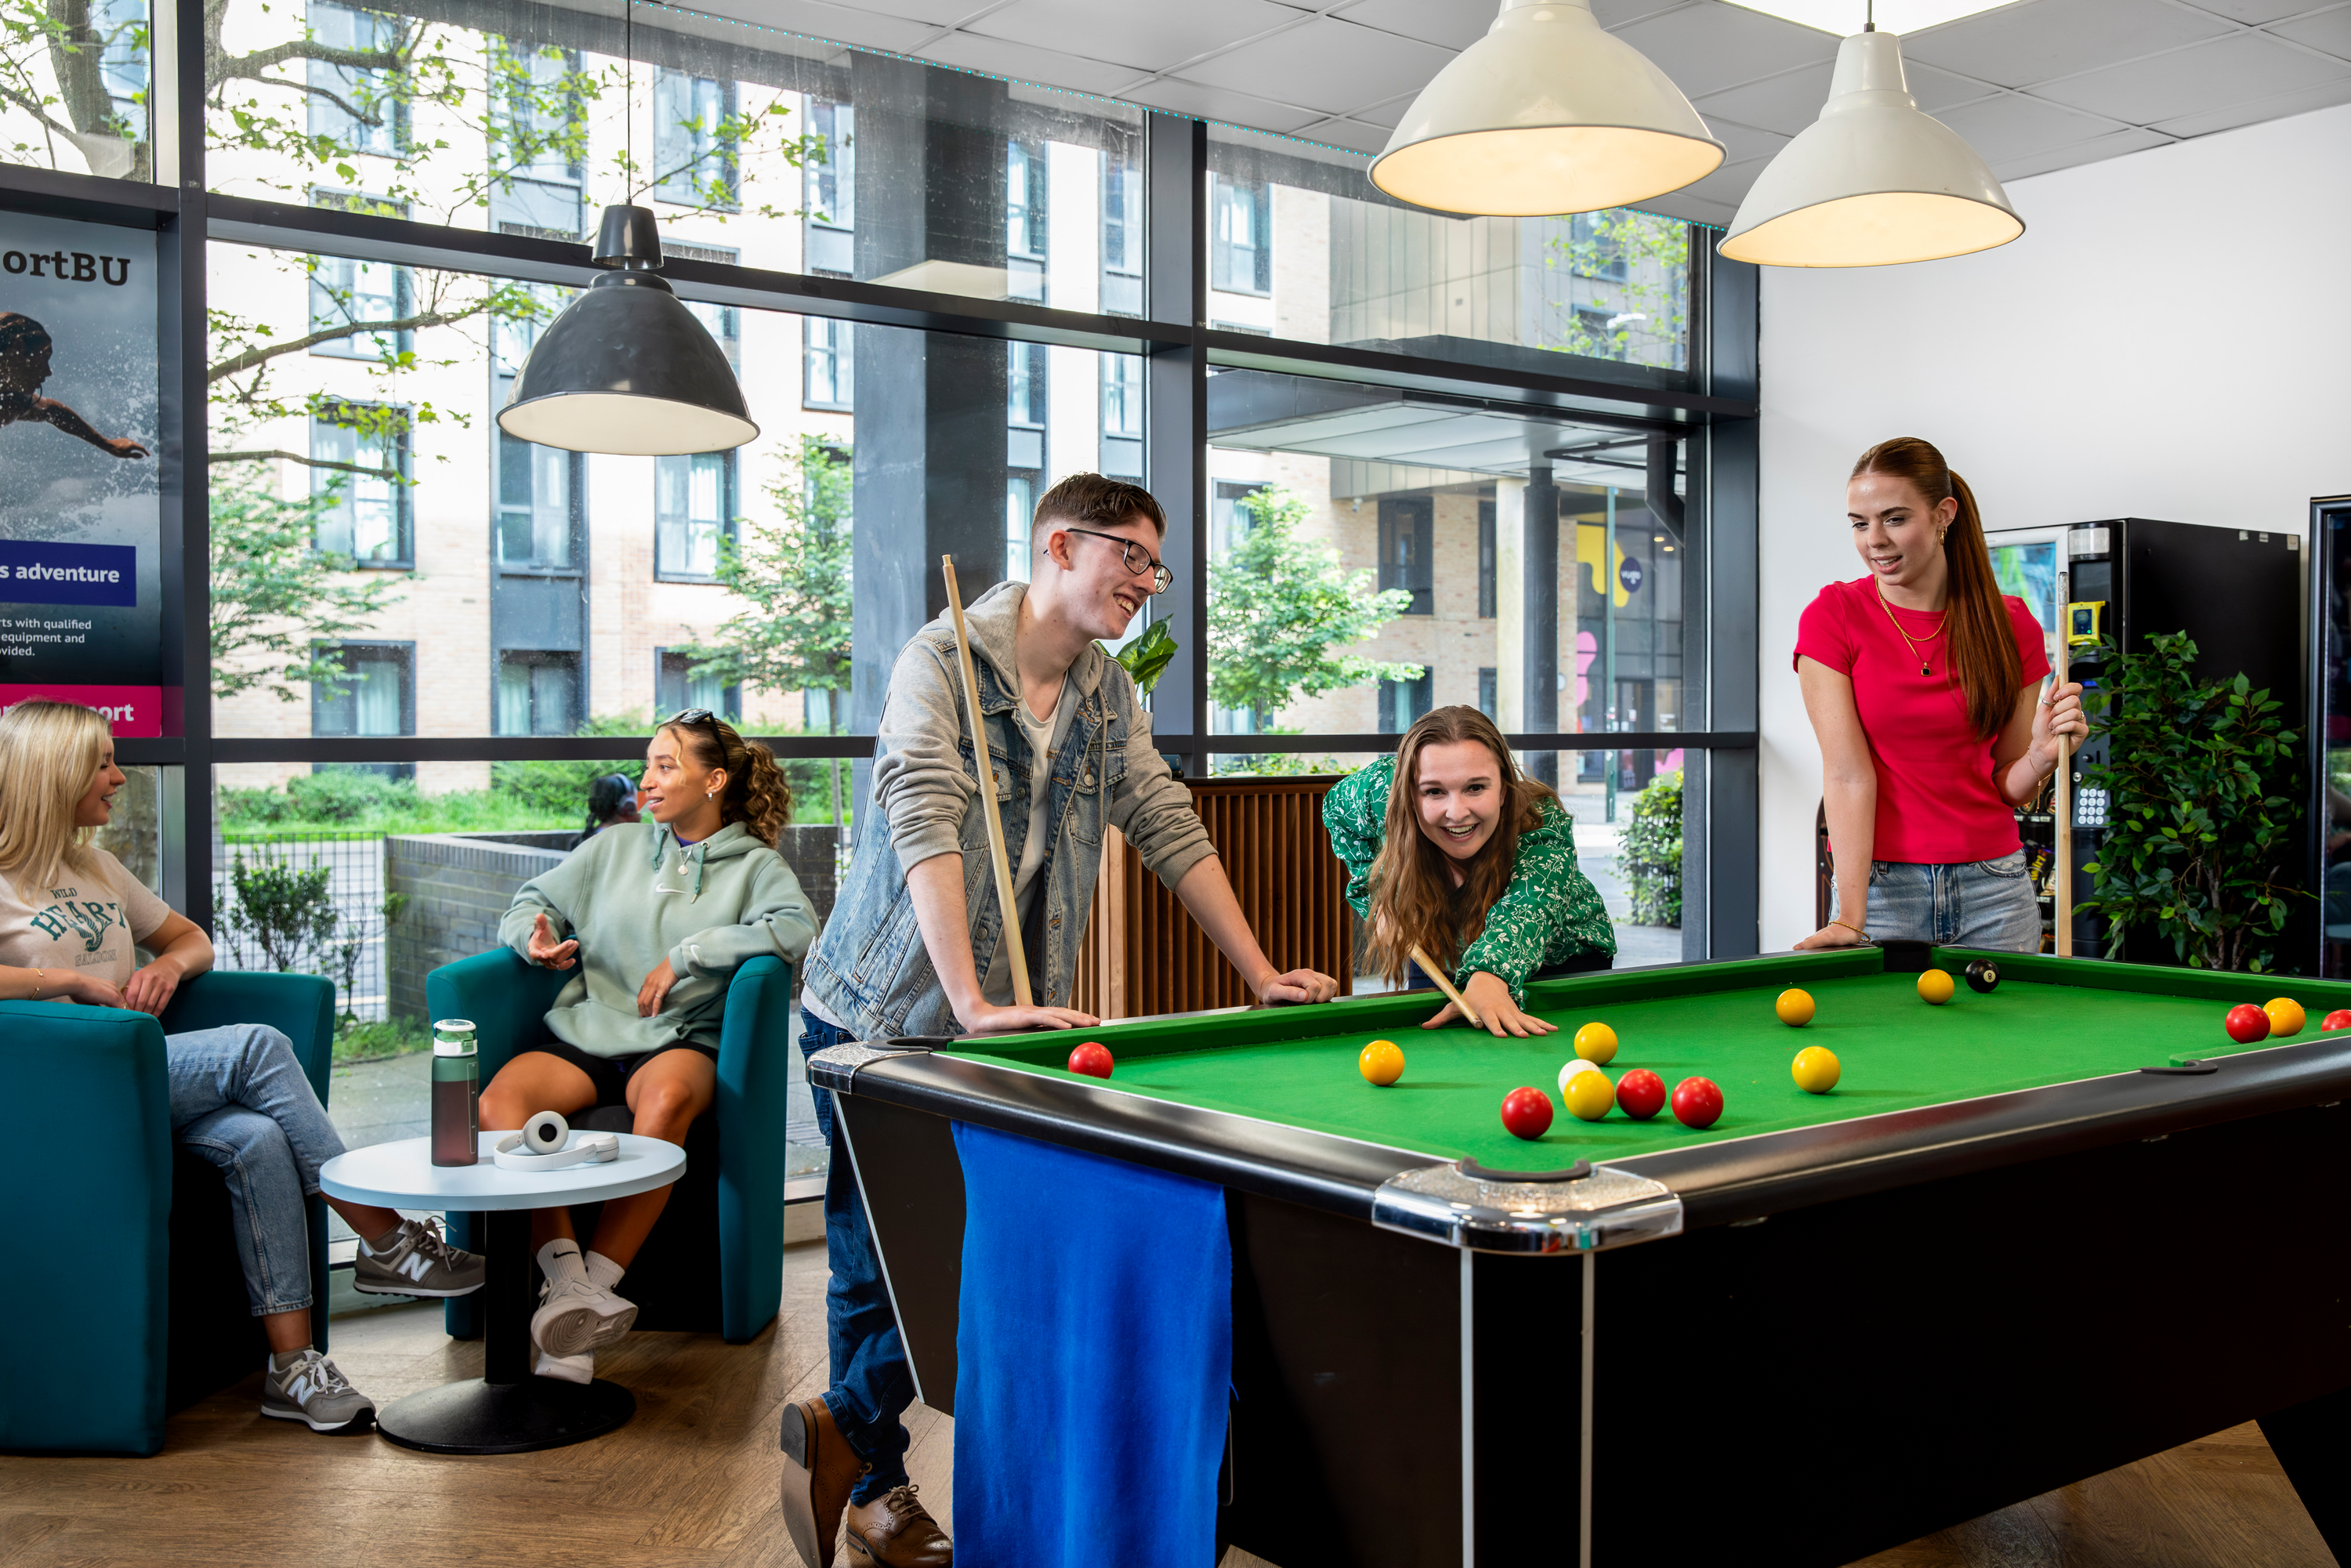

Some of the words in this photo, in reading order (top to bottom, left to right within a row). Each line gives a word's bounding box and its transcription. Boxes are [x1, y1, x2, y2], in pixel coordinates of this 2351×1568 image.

[16, 563, 120, 583] adventure
[0, 618, 12, 628] ts
[16, 617, 40, 628] with
[44, 619, 92, 631] qualified
[1, 632, 62, 644] equipment
[64, 634, 85, 643] and
[0, 646, 35, 657] vided.
[89, 704, 135, 722] ort
[50, 887, 78, 899] WILD
[30, 900, 125, 941] HEART
[74, 949, 117, 967] SALOON
